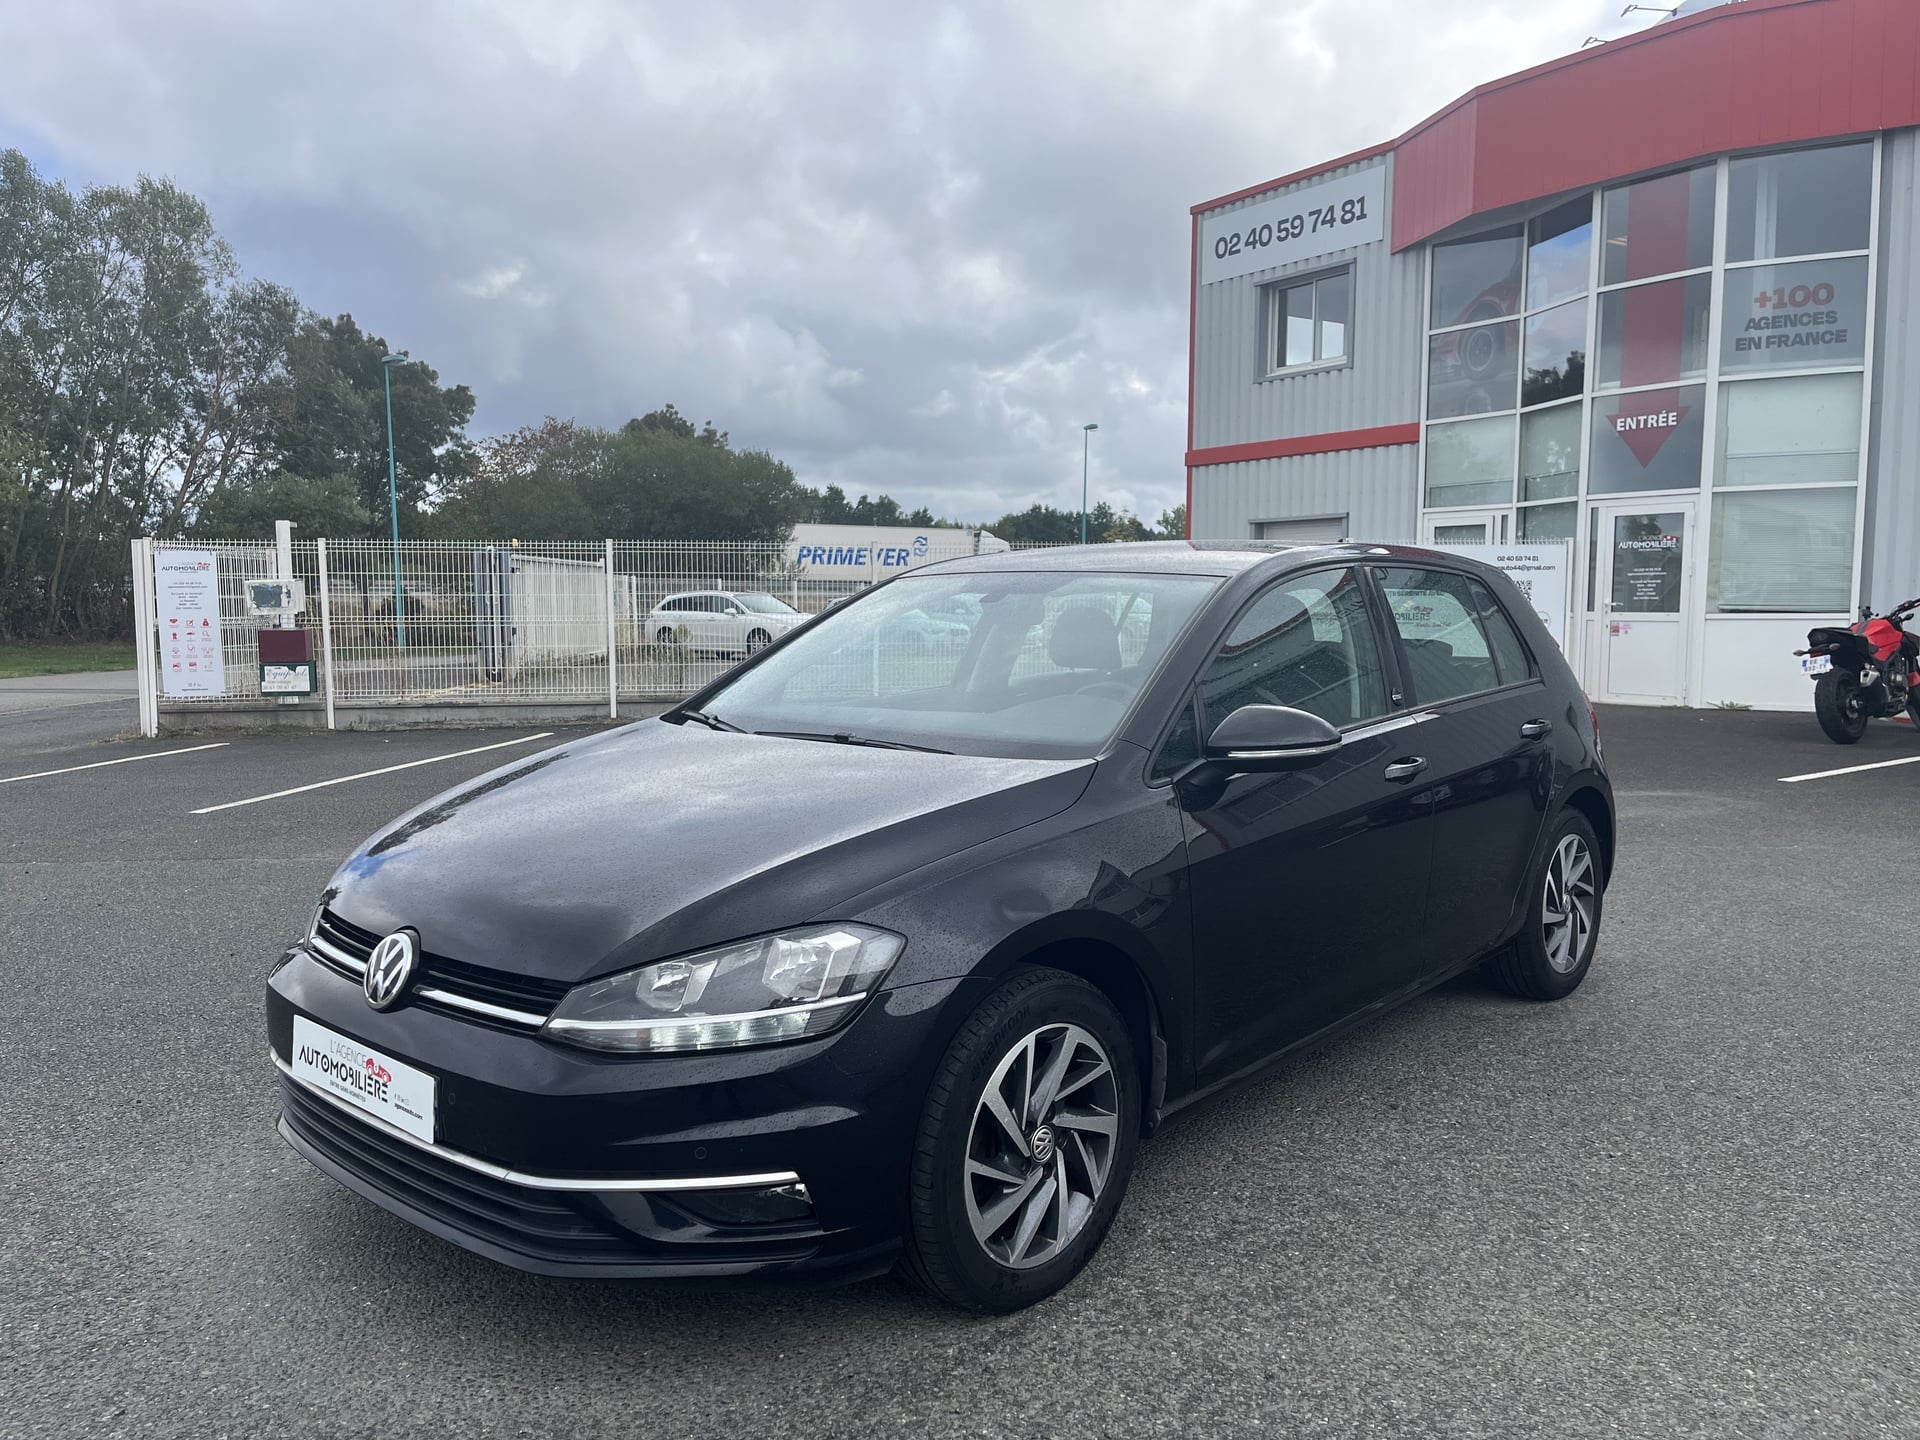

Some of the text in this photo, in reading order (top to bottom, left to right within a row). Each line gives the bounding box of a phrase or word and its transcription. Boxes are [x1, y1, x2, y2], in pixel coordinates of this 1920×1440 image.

[1215, 195, 1367, 259] 02 40 59 74 81
[1754, 283, 1835, 309] +100
[1744, 310, 1838, 332] AGENCES
[1735, 329, 1848, 352] EN FRANCE
[1616, 410, 1677, 432] ENTRÉE
[797, 545, 910, 567] PRIMEVER
[1394, 612, 1431, 621] OBILIERE
